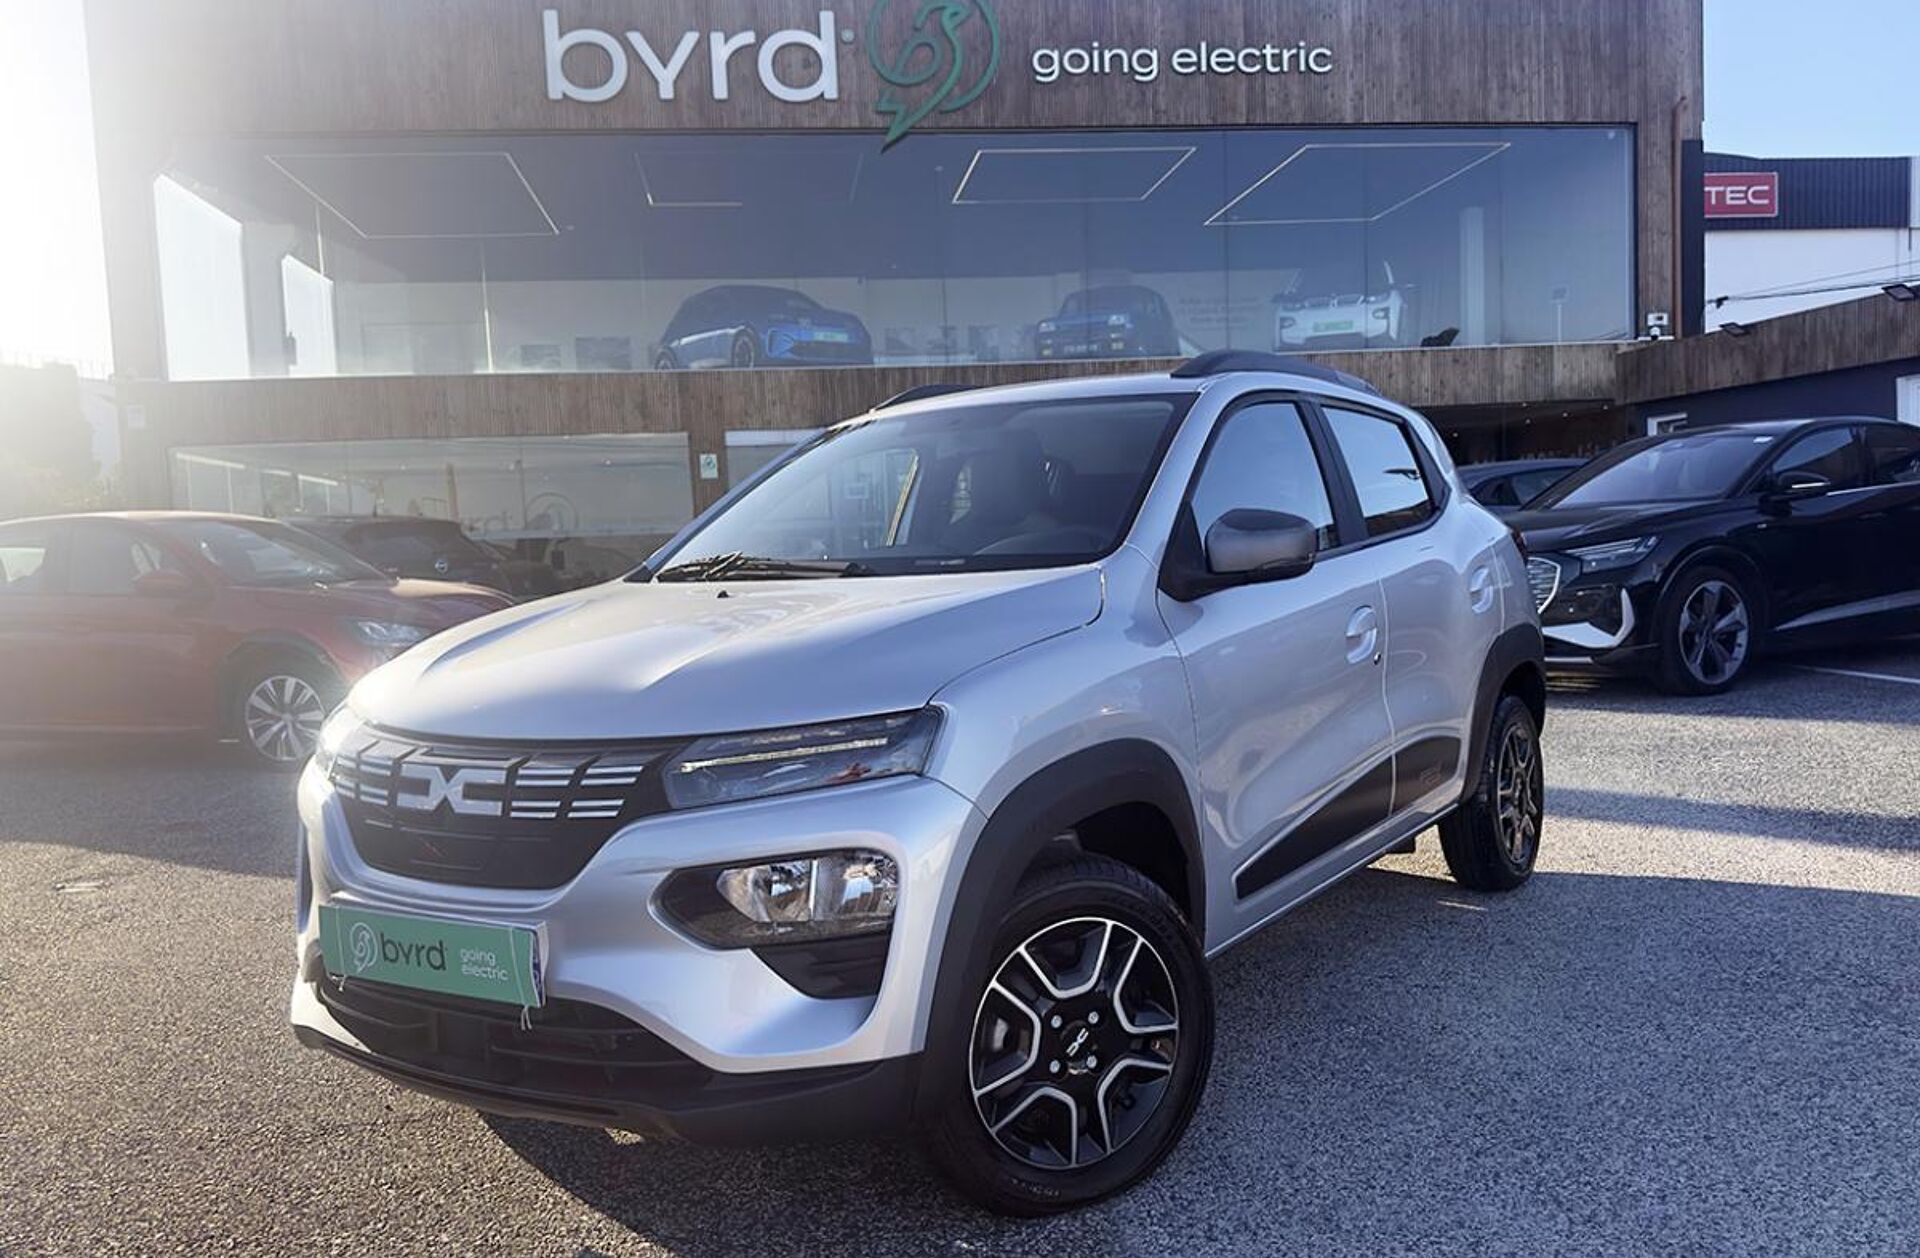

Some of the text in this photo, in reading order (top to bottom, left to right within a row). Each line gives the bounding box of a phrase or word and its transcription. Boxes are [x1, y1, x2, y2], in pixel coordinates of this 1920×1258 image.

[543, 9, 839, 103] byrd
[1032, 40, 1334, 83] going electric
[1704, 185, 1770, 206] TEC
[380, 932, 447, 971] byrd
[460, 948, 496, 967] going
[461, 963, 509, 981] electric
